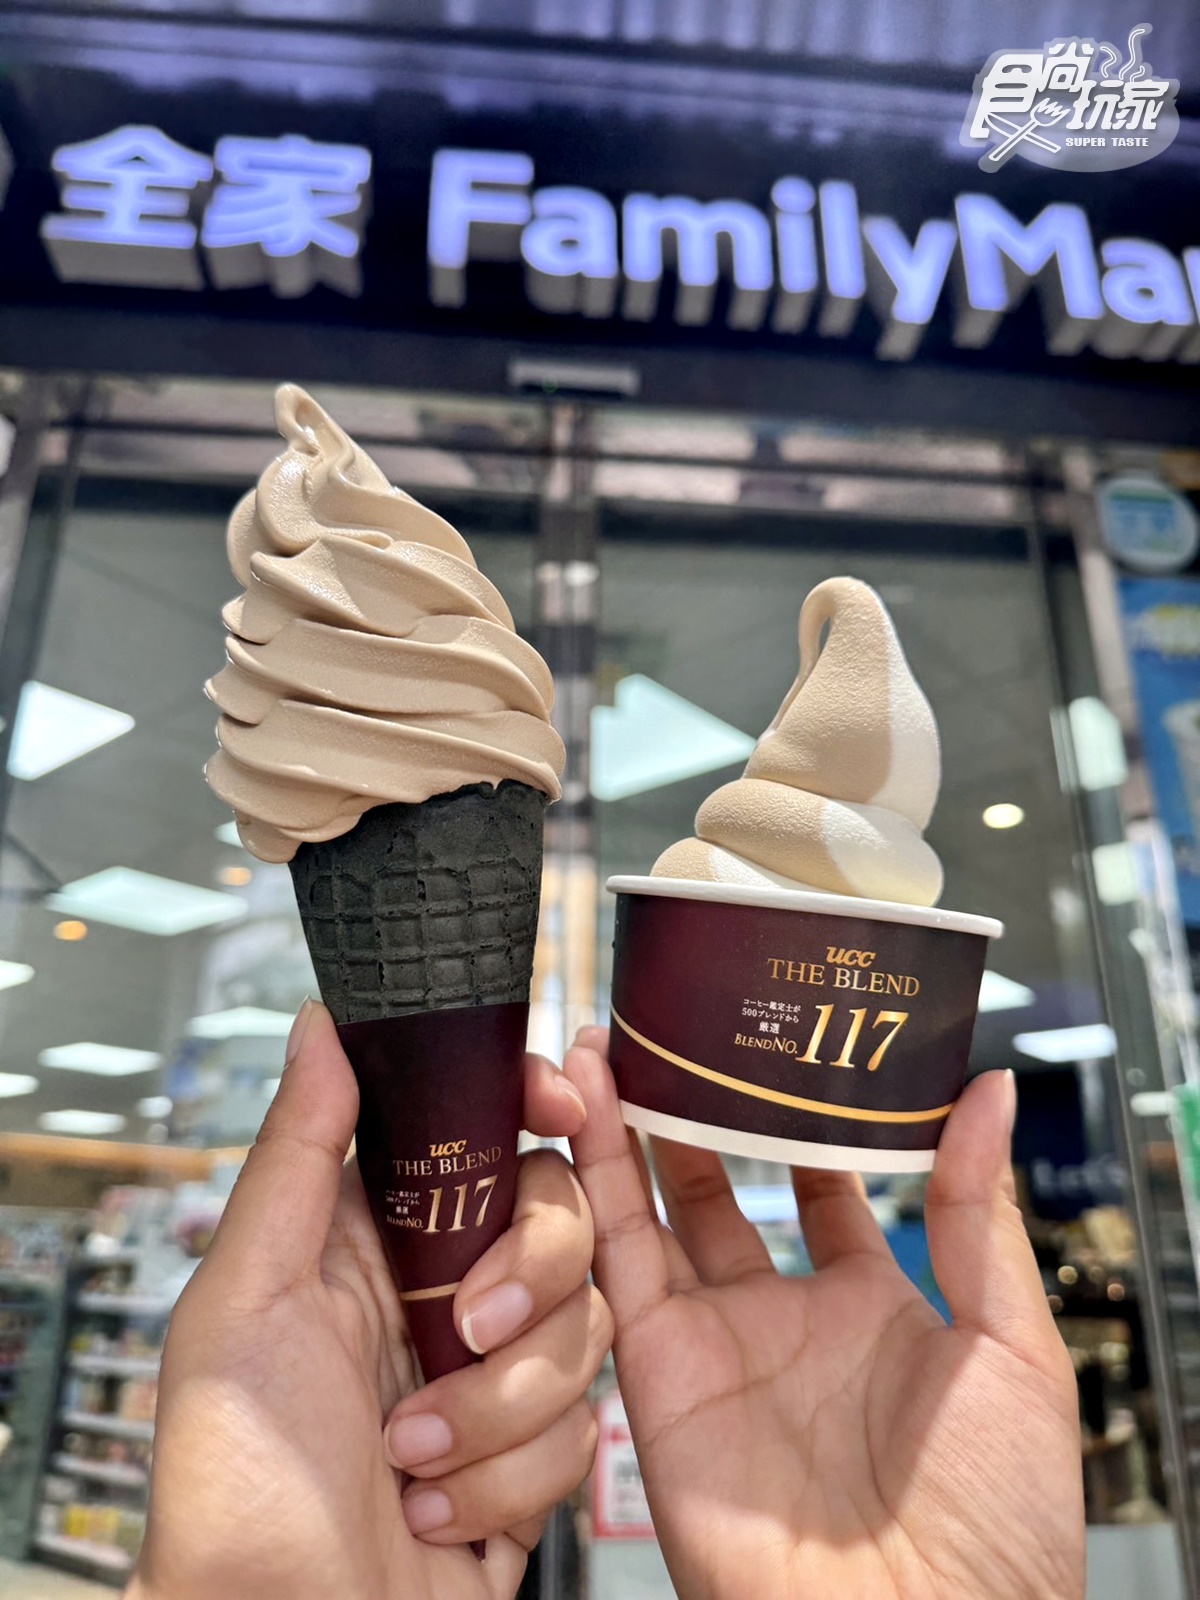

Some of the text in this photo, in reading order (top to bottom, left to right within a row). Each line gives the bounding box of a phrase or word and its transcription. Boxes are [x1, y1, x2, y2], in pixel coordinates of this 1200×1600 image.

[41, 124, 373, 259] 全家
[767, 957, 920, 997] THE BLEND
[795, 1003, 909, 1072] 117
[393, 1146, 502, 1176] THE BLEND
[422, 1174, 498, 1233] 117
